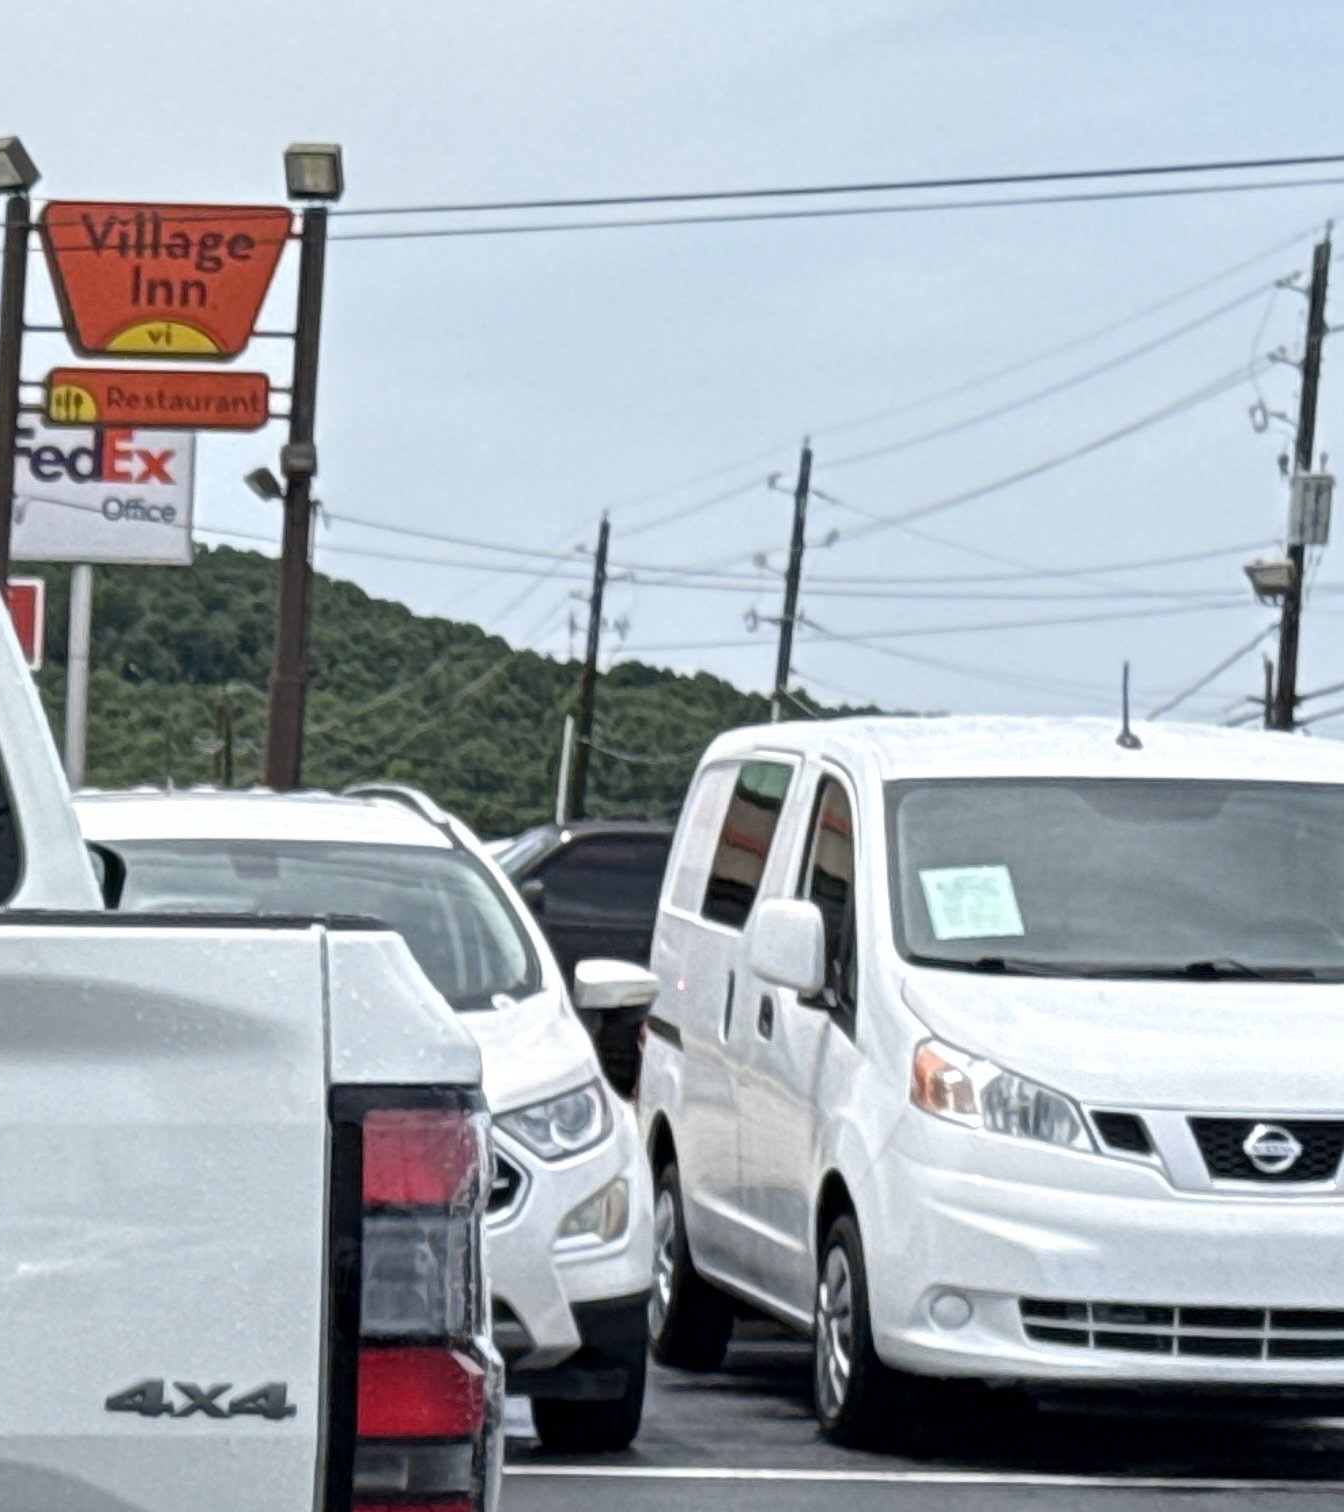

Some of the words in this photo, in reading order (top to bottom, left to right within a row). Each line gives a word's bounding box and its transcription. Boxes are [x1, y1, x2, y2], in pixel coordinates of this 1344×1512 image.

[81, 212, 255, 272] Village
[131, 267, 208, 308] Inn
[105, 384, 261, 414] Restaurant
[102, 496, 177, 523] Office
